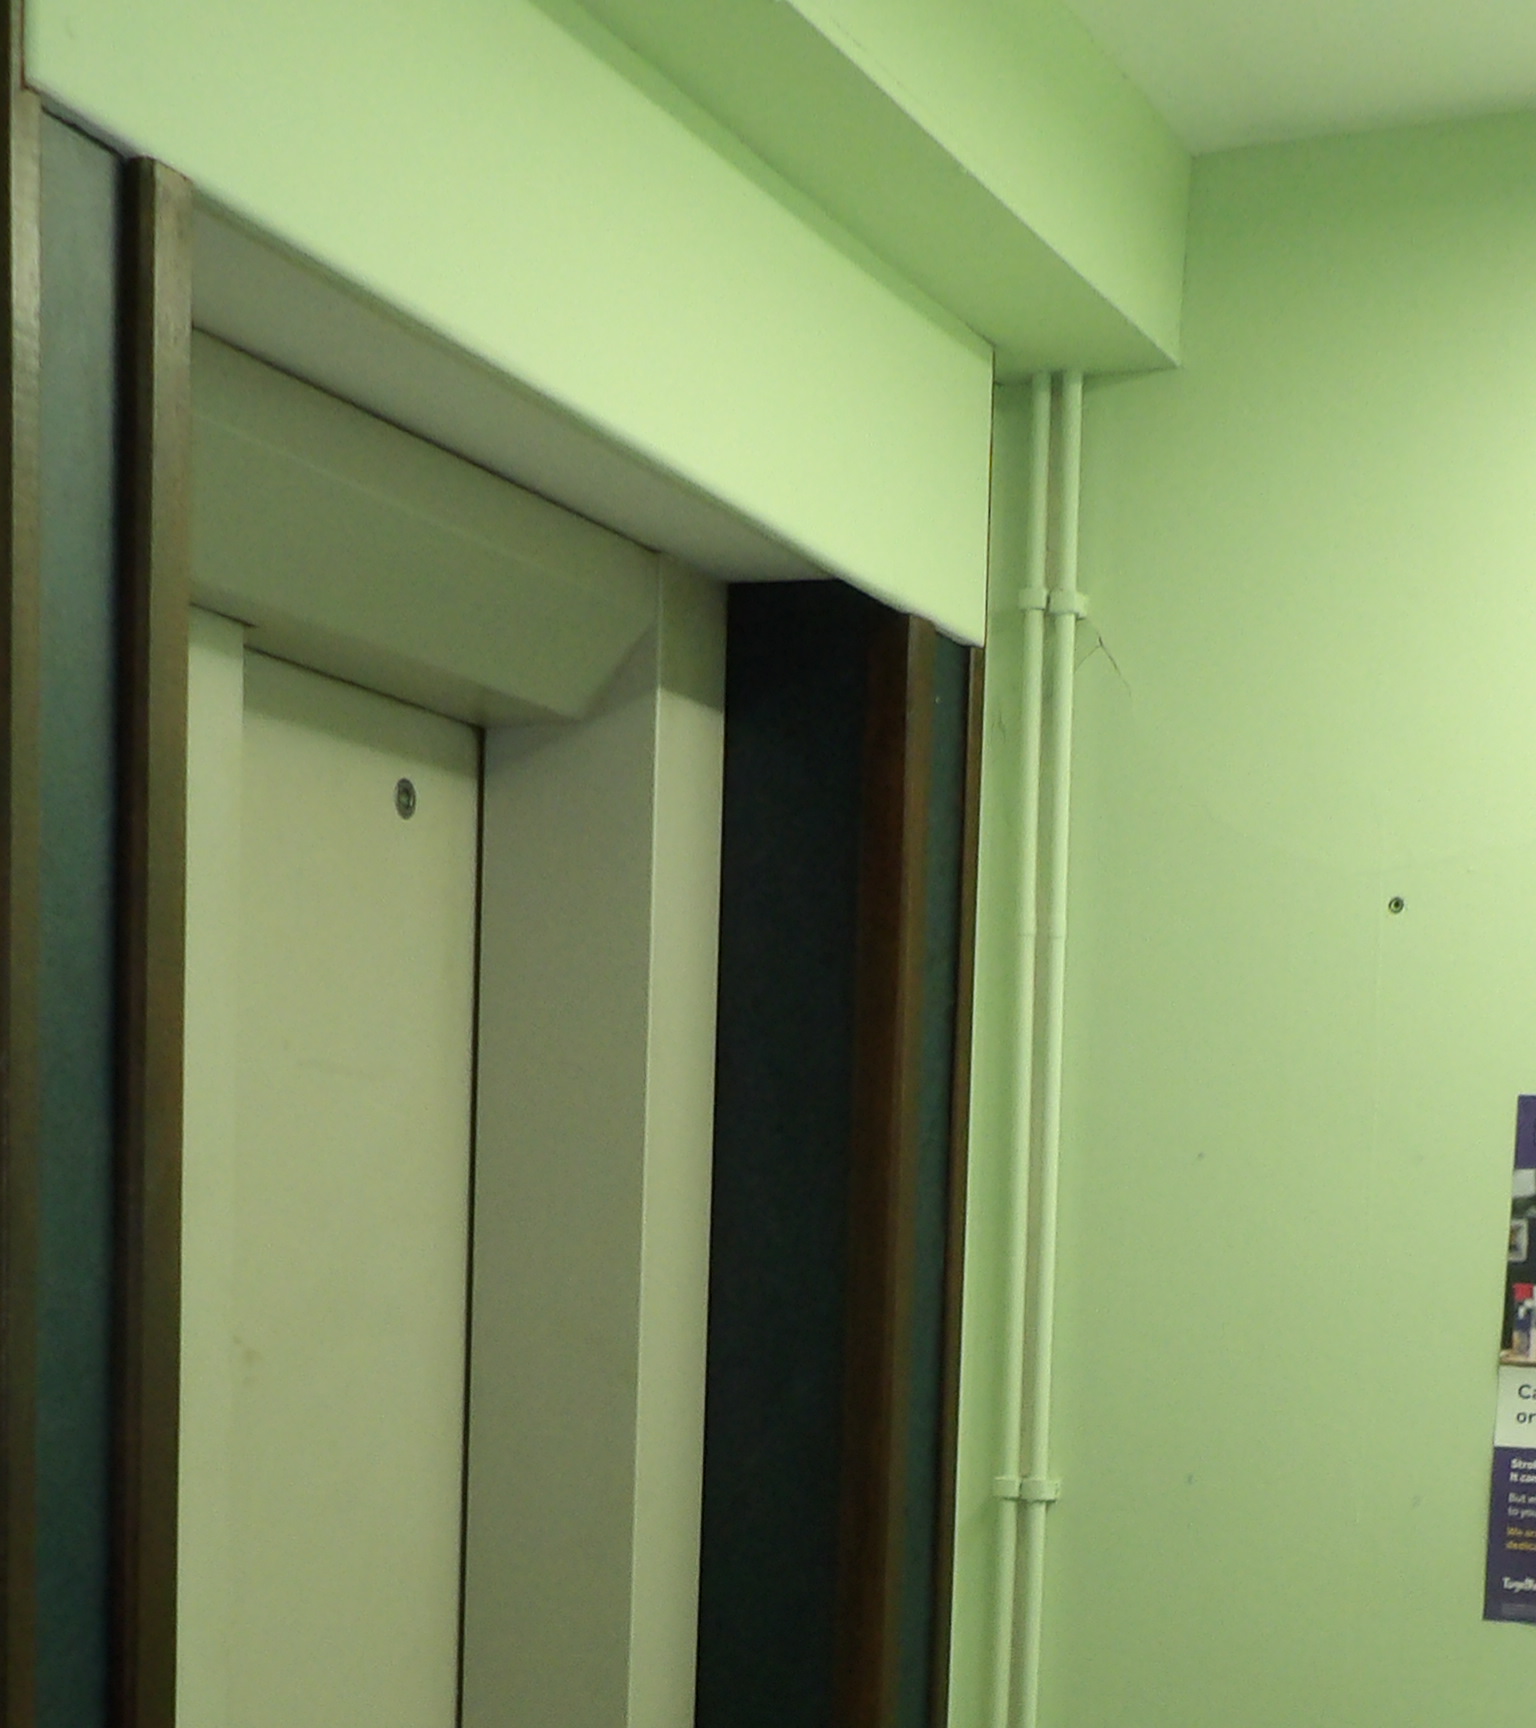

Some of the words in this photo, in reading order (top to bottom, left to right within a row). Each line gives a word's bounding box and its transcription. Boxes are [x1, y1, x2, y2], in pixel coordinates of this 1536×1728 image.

[1516, 1411, 1536, 1424] or
[1510, 1471, 1518, 1482] It
[1508, 1492, 1526, 1503] But
[1508, 1506, 1519, 1516] to
